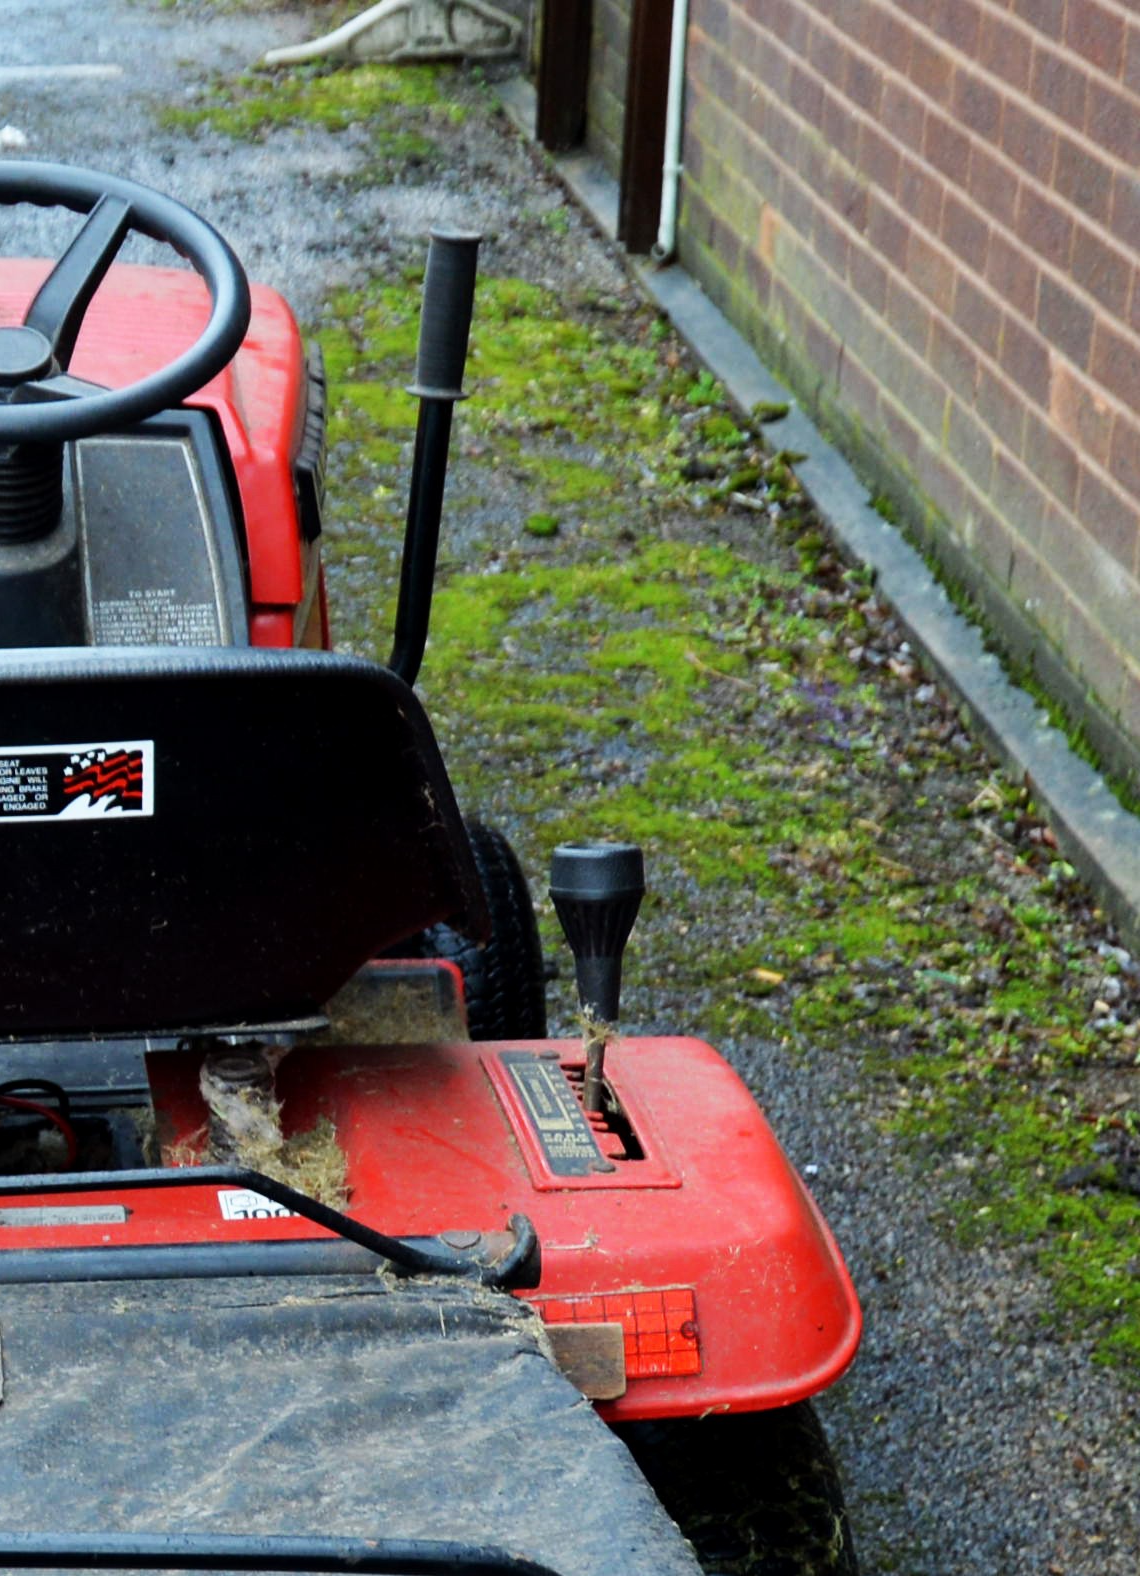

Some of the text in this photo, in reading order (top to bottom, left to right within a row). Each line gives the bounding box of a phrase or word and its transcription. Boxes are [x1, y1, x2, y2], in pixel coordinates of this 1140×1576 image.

[128, 588, 176, 598] TO START
[14, 767, 48, 776] LEAVES
[27, 776, 48, 784] WILL
[34, 793, 48, 801] OR
